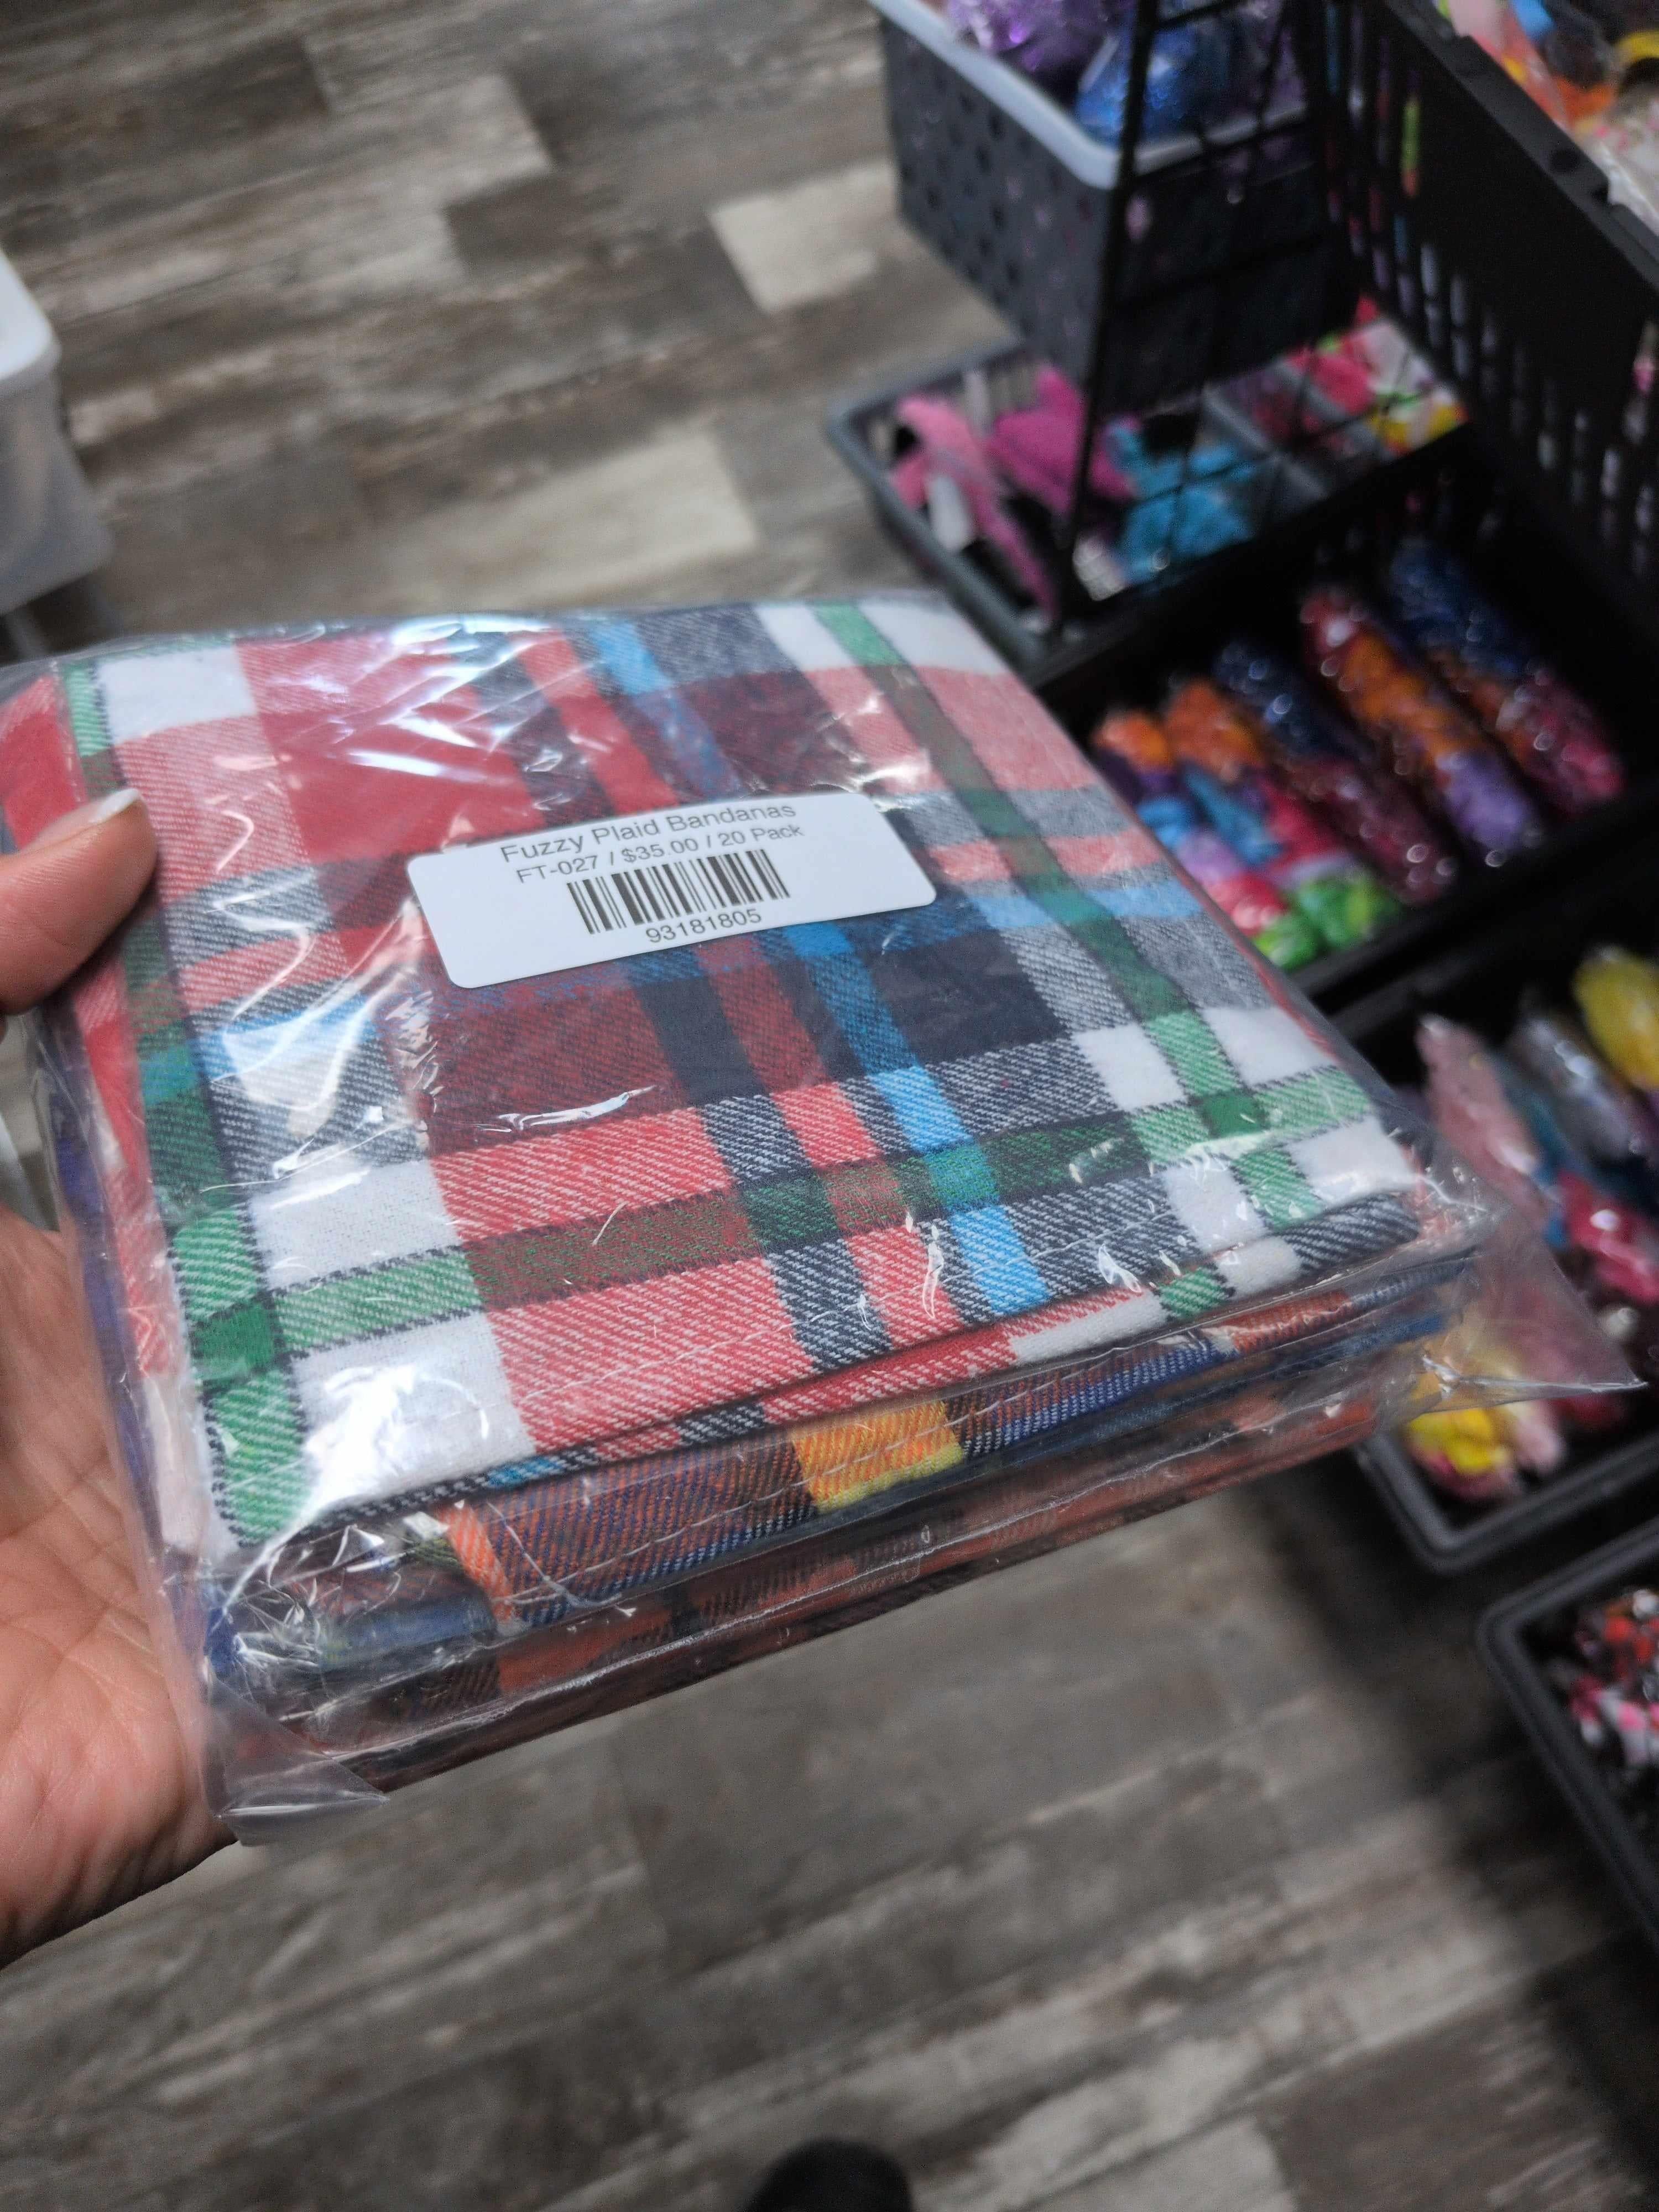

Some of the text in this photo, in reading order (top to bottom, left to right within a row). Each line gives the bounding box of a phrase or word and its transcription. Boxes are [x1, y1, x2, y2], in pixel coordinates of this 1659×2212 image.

[500, 806, 797, 863] Fuzzy Plaid Bandanas
[516, 824, 805, 884] FT-027 / $35.00 / 20 Pack
[645, 909, 762, 943] 93181805
